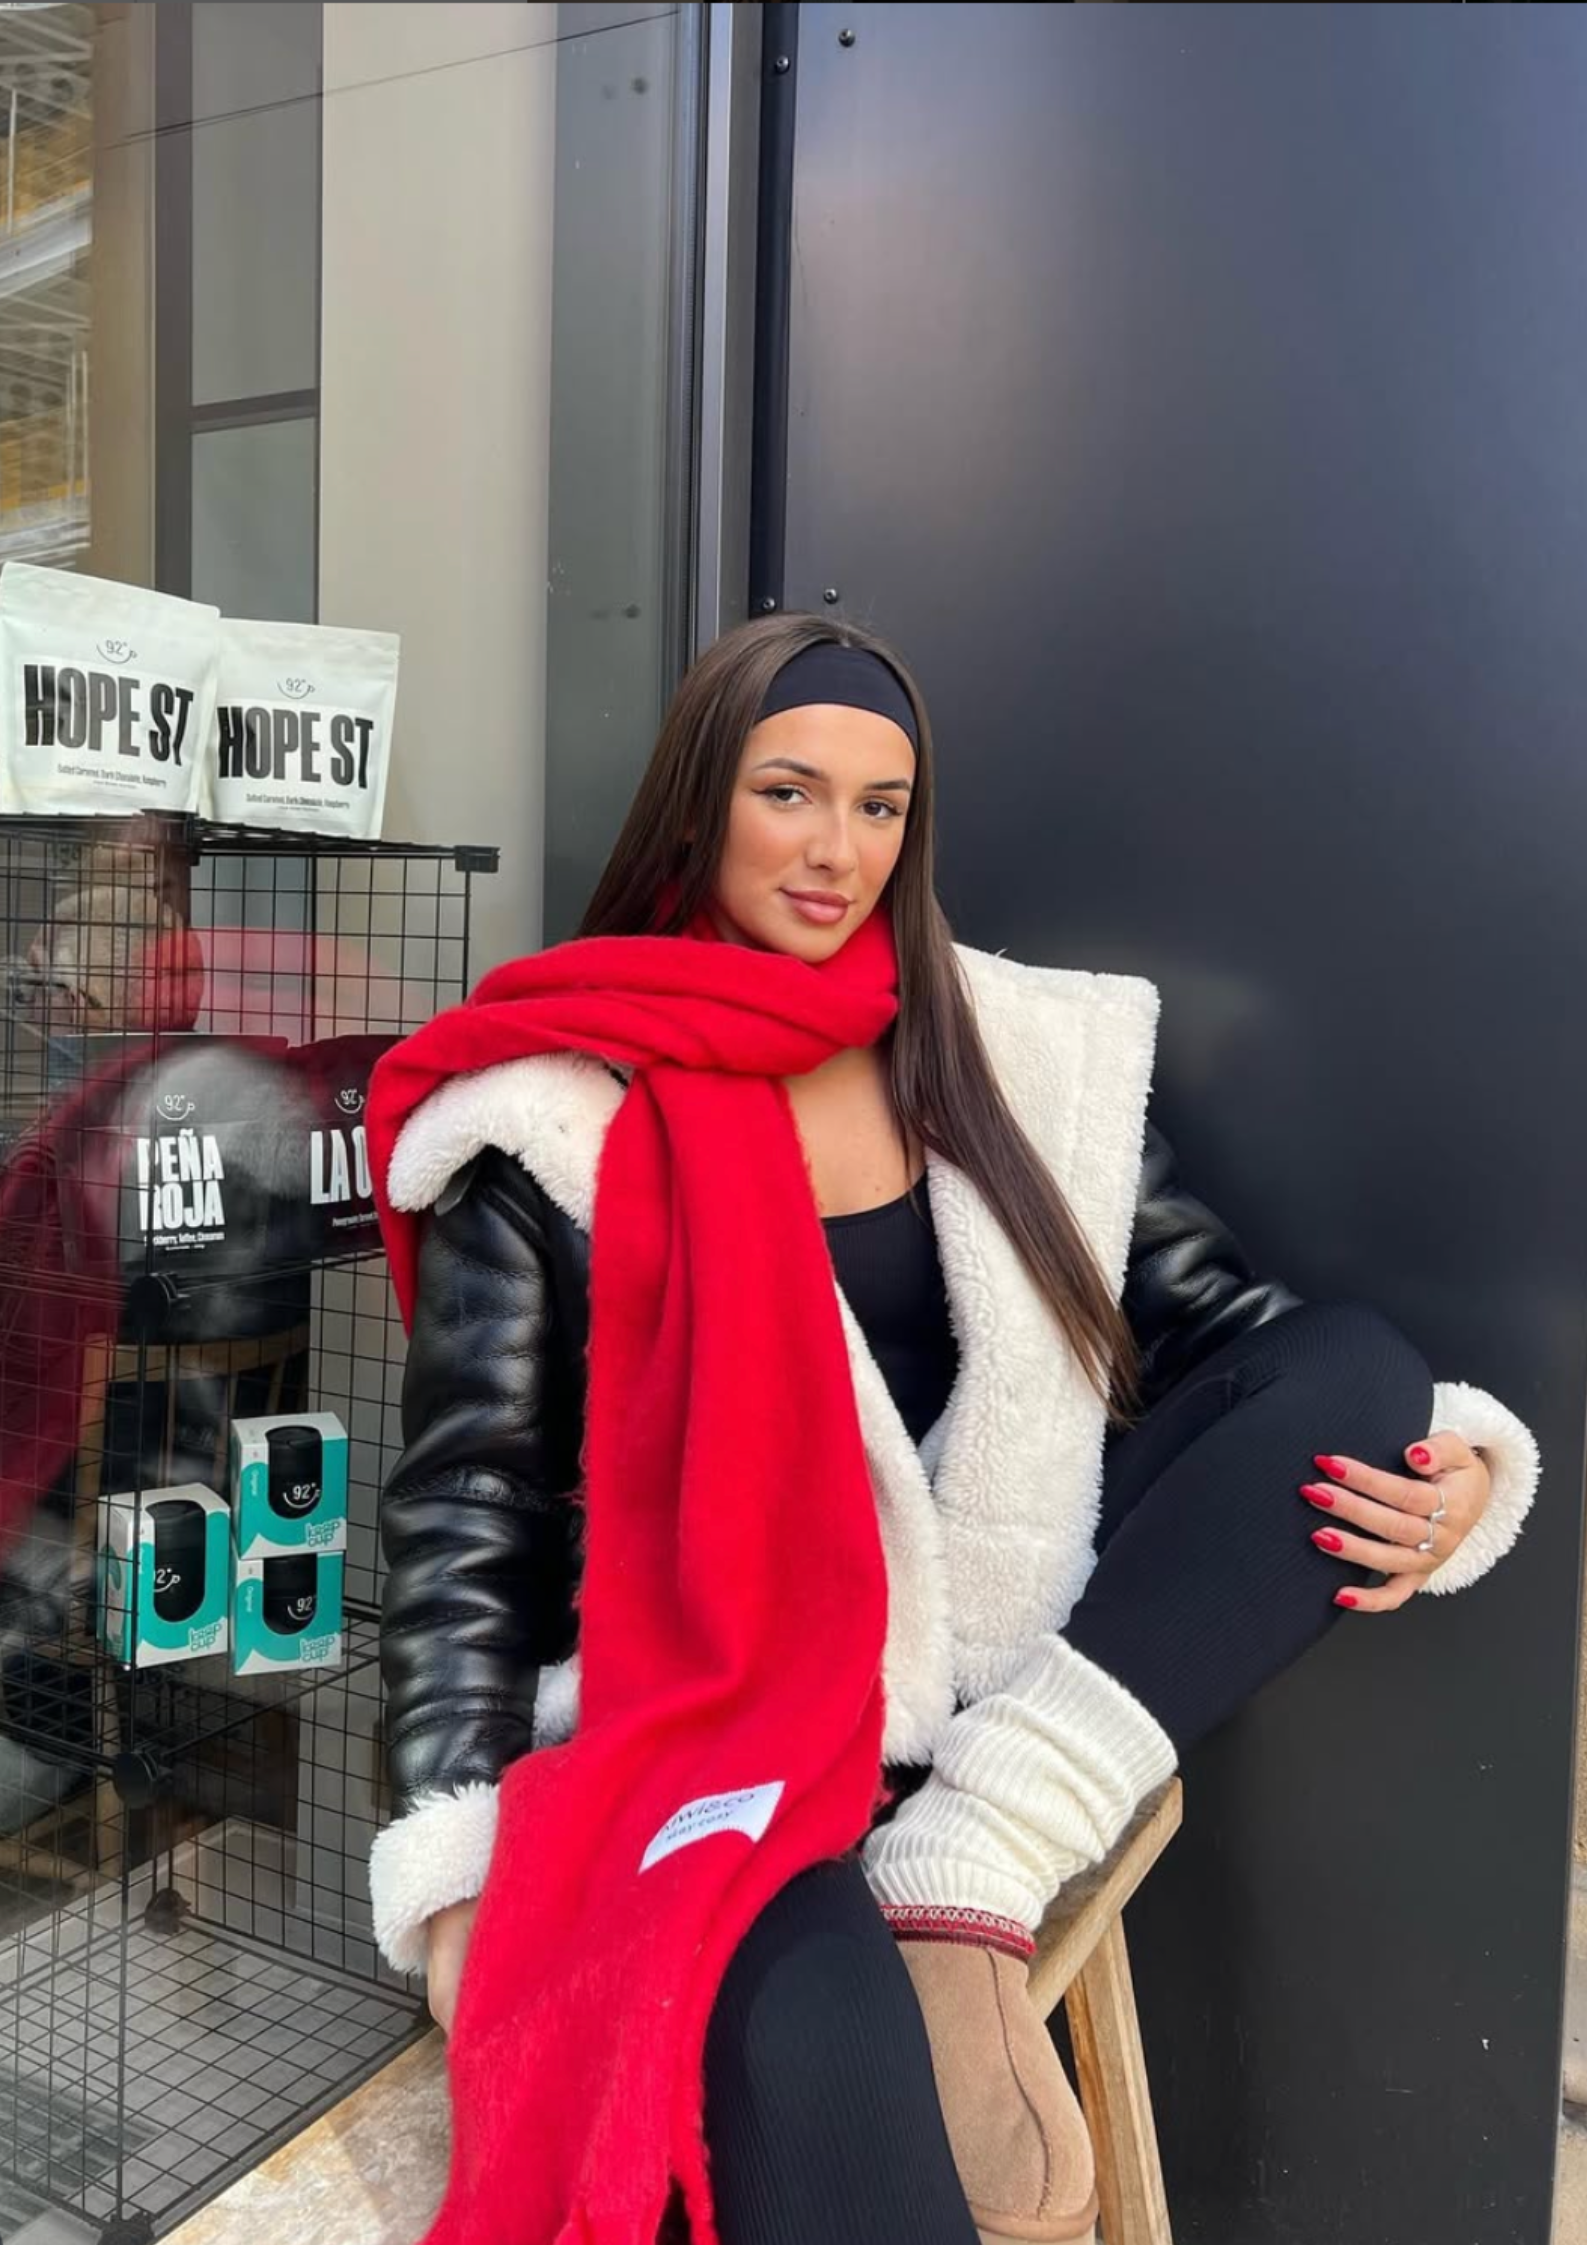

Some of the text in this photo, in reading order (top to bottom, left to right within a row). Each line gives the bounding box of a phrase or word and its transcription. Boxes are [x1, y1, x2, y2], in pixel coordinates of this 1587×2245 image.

[23, 663, 194, 767] HOPE ST
[216, 705, 375, 789] HOPE ST
[137, 1128, 224, 1184] PEÑA
[310, 1126, 373, 1204] LA O
[139, 1180, 226, 1232] ROJA
[154, 1567, 172, 1584] 2°
